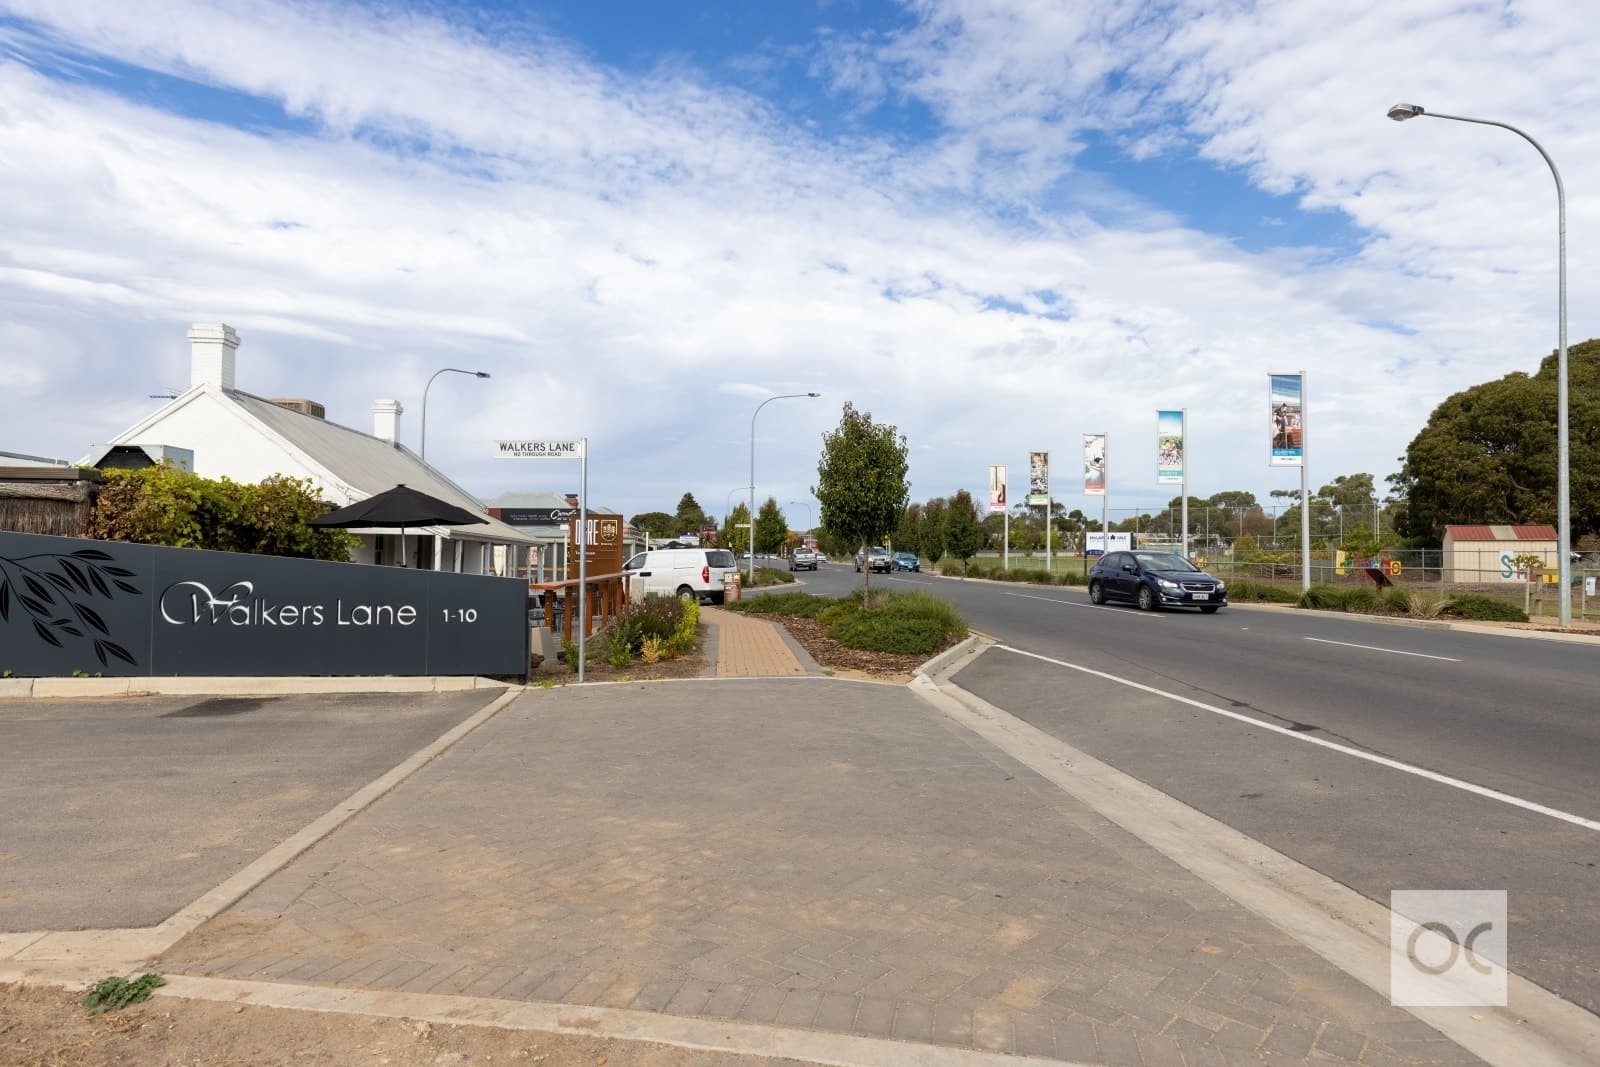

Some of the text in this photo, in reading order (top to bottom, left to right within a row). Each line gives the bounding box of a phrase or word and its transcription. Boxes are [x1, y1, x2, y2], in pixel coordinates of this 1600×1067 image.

[499, 442, 576, 452] WALKERS LANE
[159, 580, 479, 626] Walkers Lane 1-10
